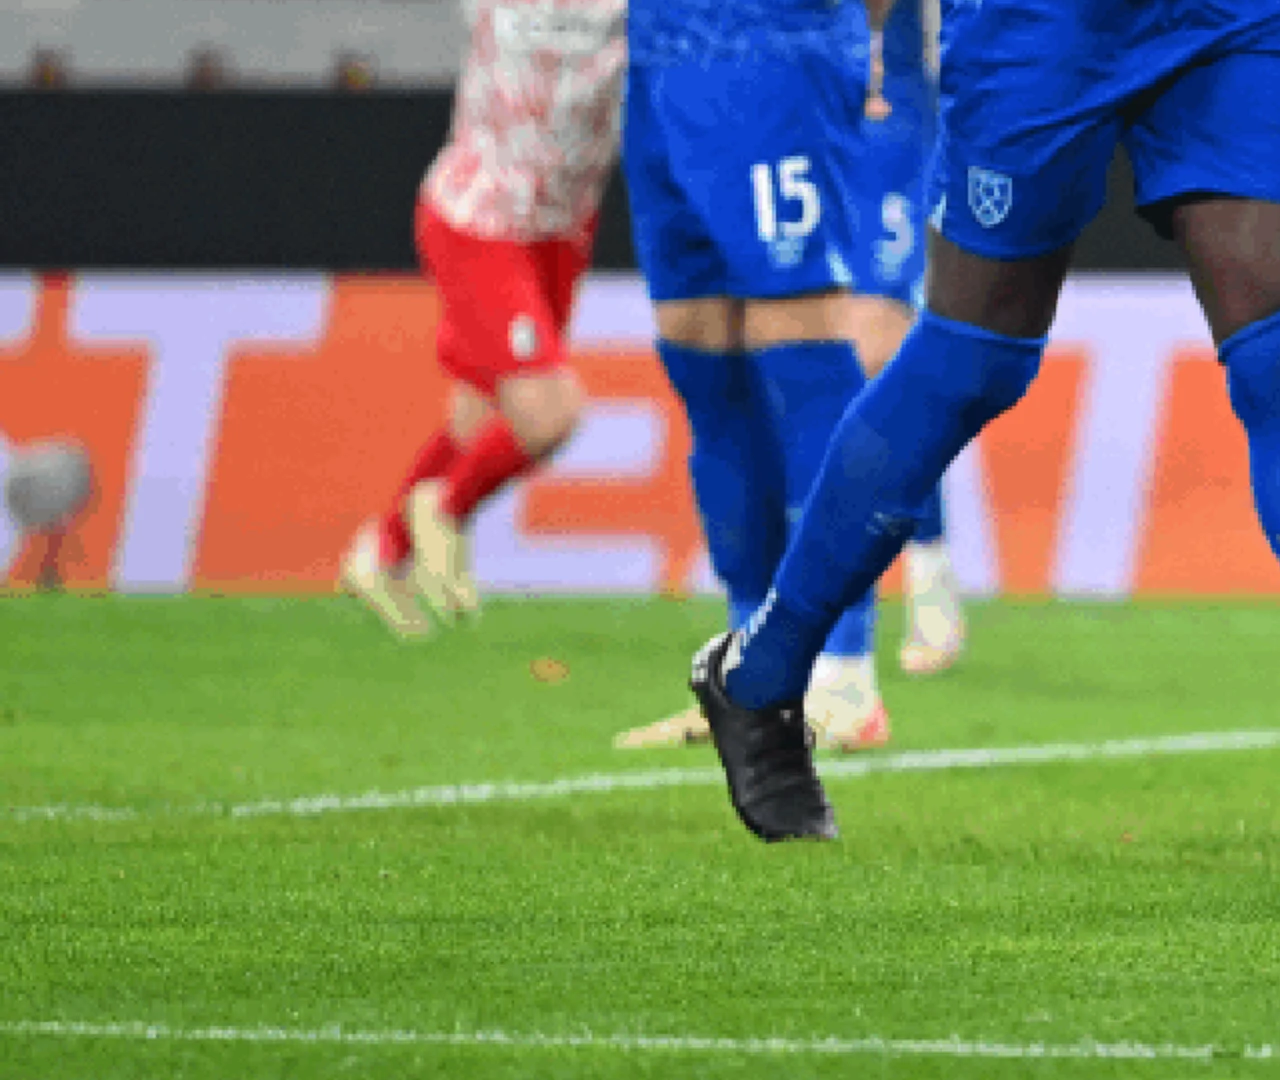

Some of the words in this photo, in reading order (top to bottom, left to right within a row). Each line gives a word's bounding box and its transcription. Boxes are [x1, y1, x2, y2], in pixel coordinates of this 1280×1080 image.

[751, 155, 821, 243] 15
[0, 273, 332, 593] T
[470, 273, 1222, 597] ET
